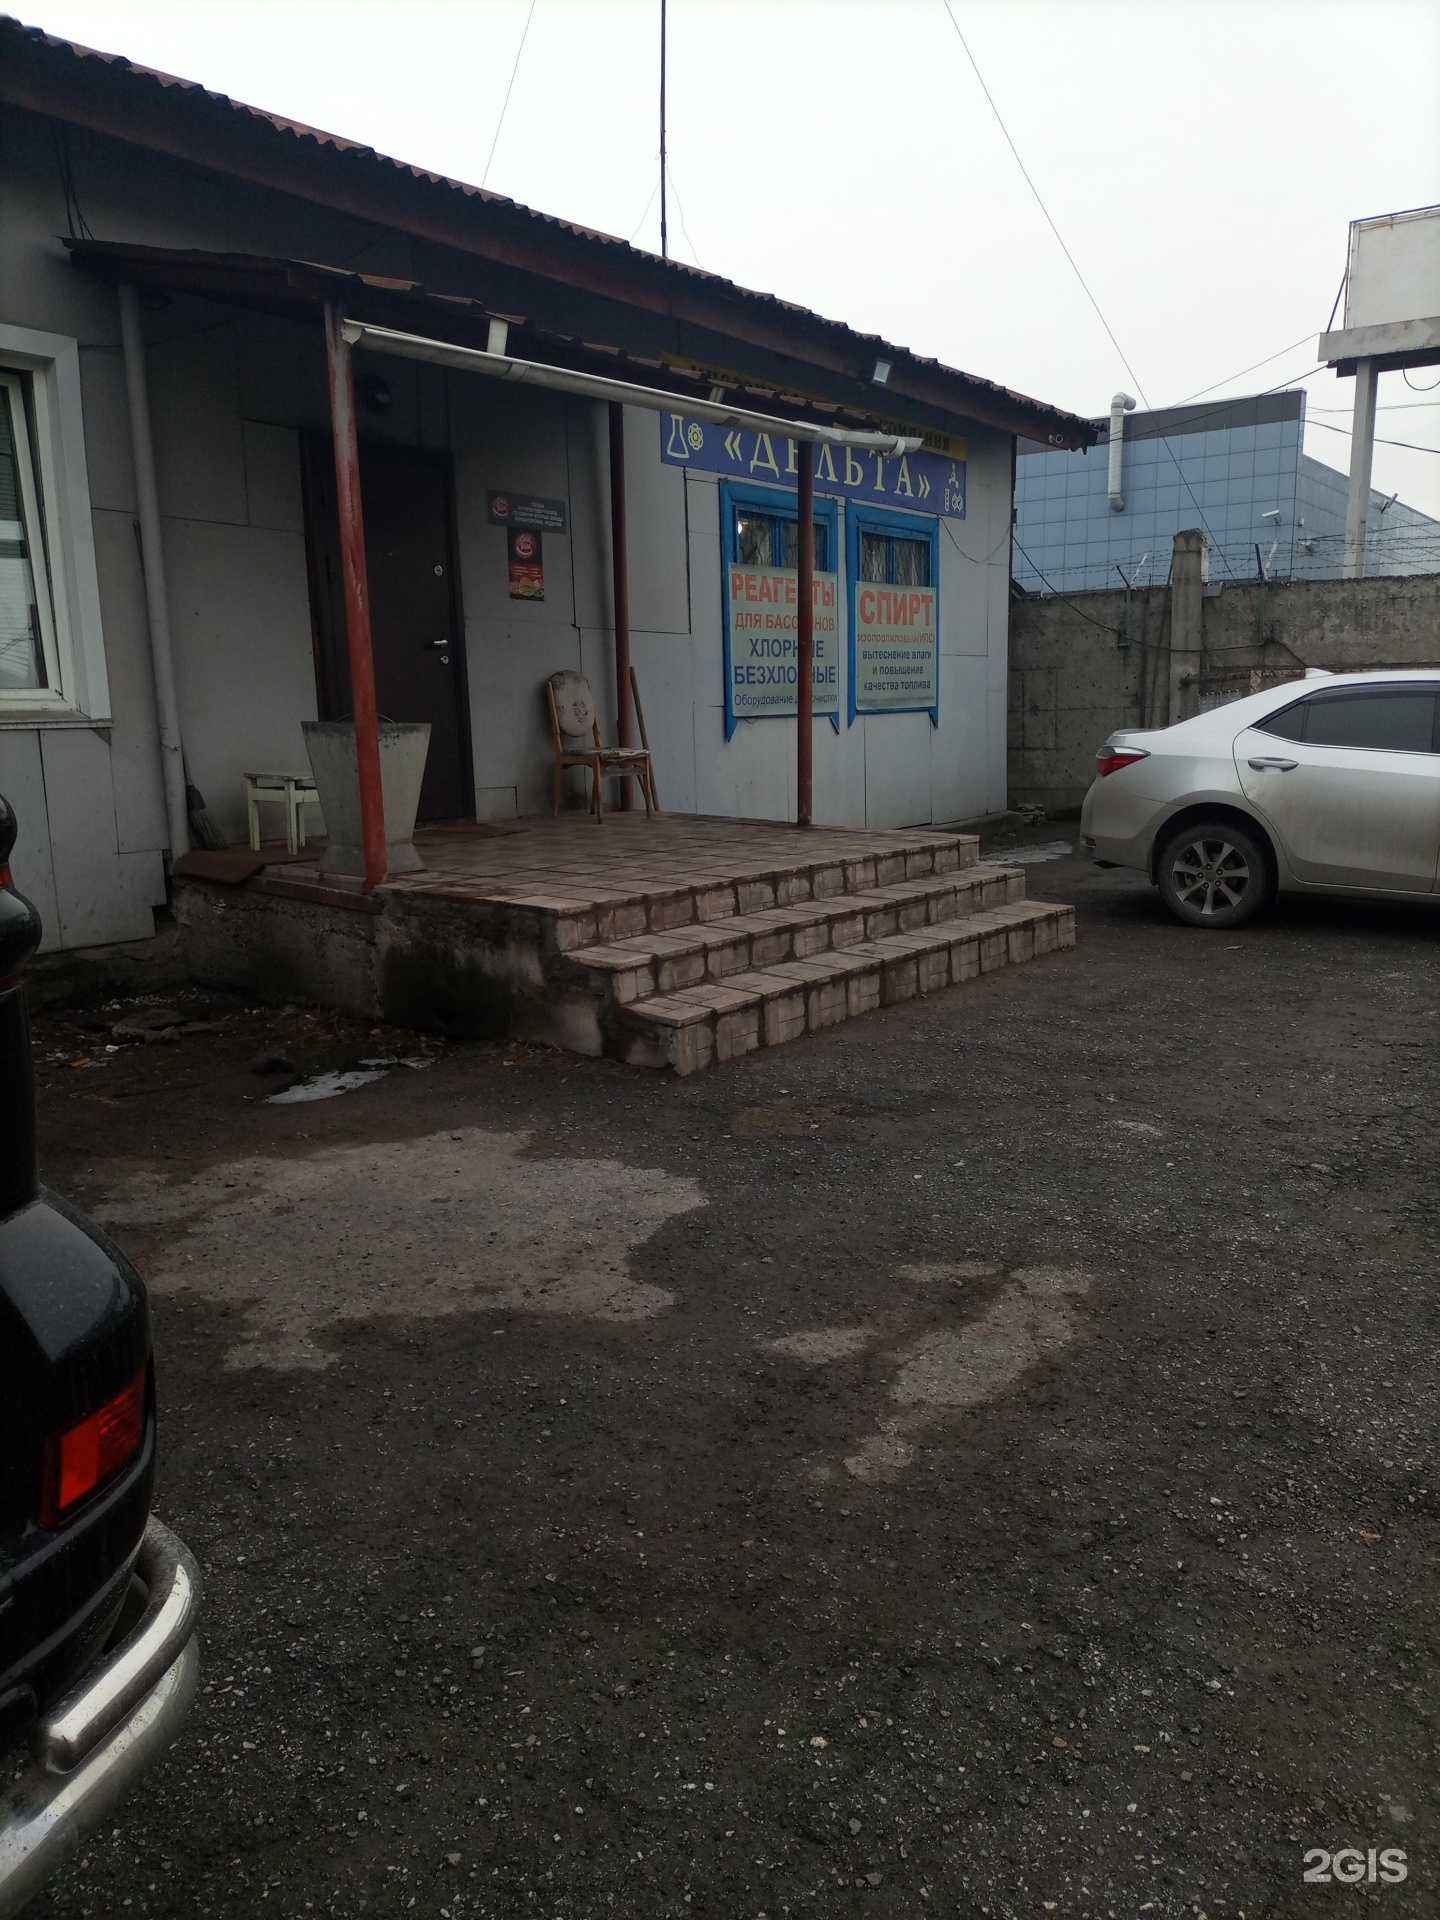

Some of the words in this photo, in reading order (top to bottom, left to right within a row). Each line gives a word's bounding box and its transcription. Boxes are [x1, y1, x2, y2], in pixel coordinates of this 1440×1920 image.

[731, 574, 835, 608] РЕАГЕТЫ
[859, 591, 934, 626] СПИРТ
[735, 613, 762, 630] ДЛЯ
[766, 615, 834, 632] БАССНОВ
[749, 639, 825, 658] ХЛОРНЕ
[734, 694, 793, 709] Оборудование
